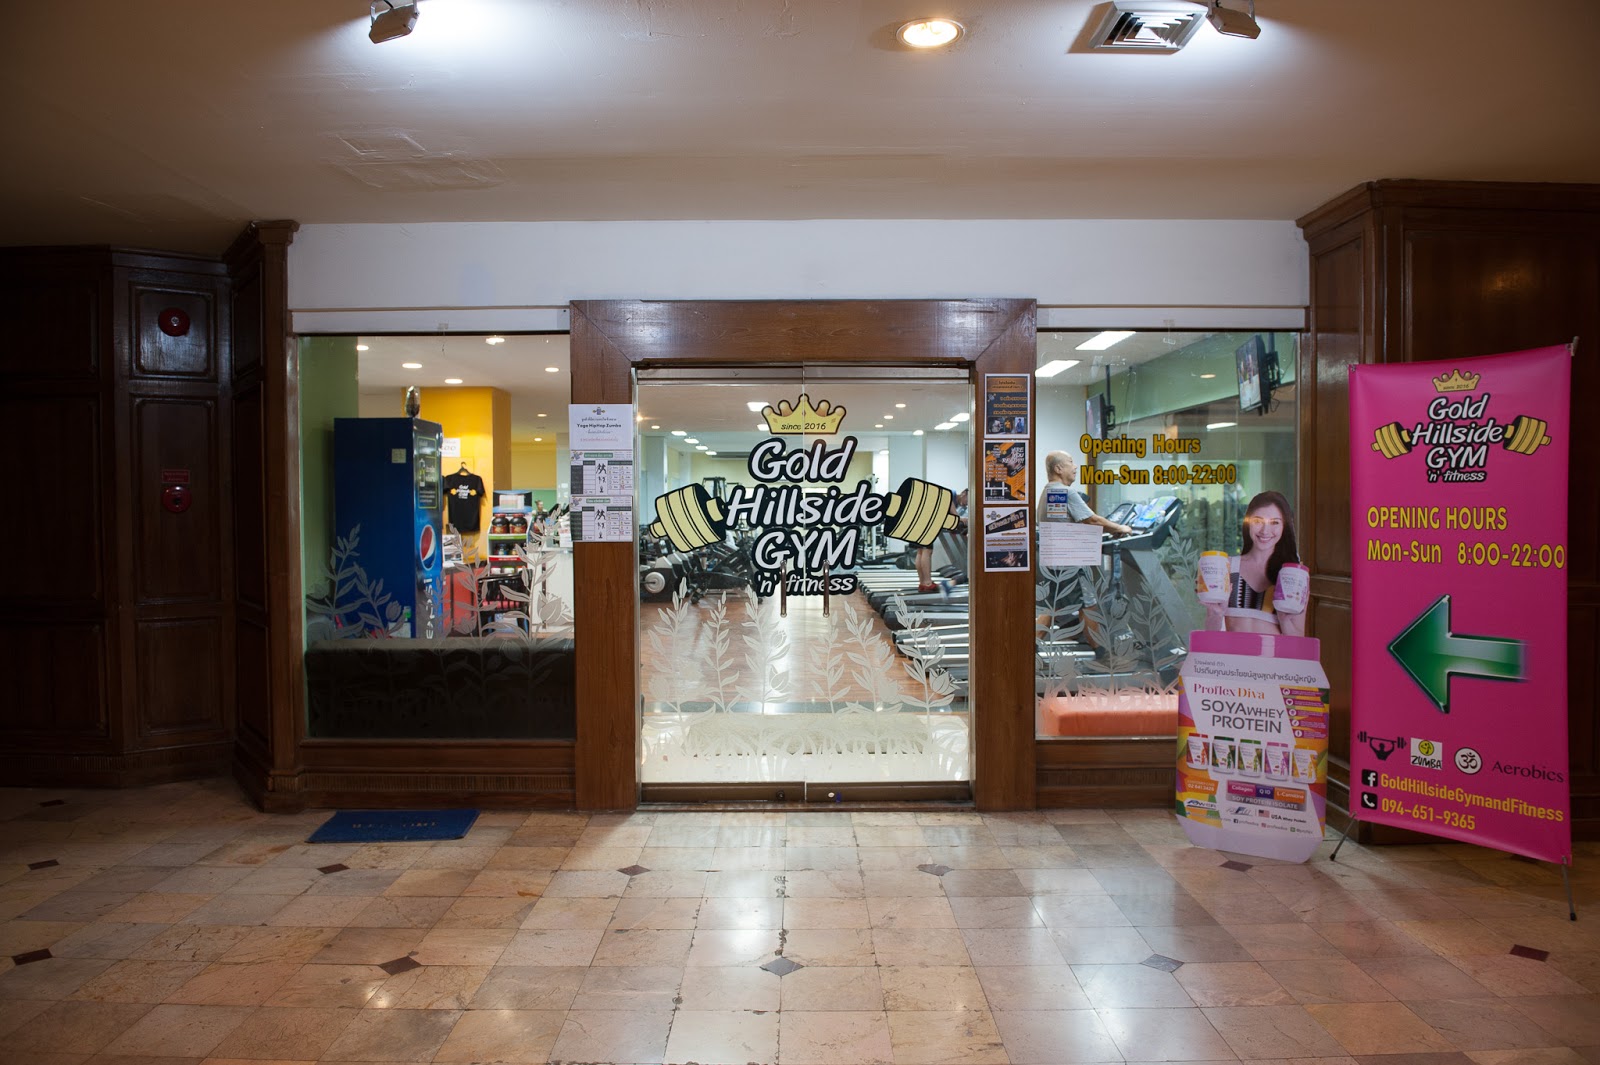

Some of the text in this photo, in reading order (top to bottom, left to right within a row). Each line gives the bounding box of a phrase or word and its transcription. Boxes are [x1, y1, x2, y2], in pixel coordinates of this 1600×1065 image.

[1428, 394, 1489, 420] Gold
[780, 422, 826, 431] since 2016
[1412, 420, 1503, 445] Hillside
[1080, 434, 1201, 458] Opening Hours
[1426, 445, 1488, 468] GYM
[749, 438, 856, 481] Gold
[1080, 464, 1236, 484] Mon-Sun 8:00-22:00
[1443, 470, 1486, 482] fitness
[725, 482, 885, 528] Hillside
[1368, 506, 1508, 530] OPENING HOURS
[754, 527, 858, 571] GYM
[1367, 540, 1565, 568] Mon-Sun 8:00-22:00
[786, 573, 854, 594] fitness
[1194, 683, 1265, 700] Proflex Diva
[1212, 714, 1282, 733] PROTEIN
[1412, 756, 1442, 768] ZUMBA
[1492, 762, 1564, 783] Aerobics
[1232, 785, 1253, 793] Collagen
[1381, 774, 1564, 822] GoldHillsideGymandFitness
[1246, 797, 1272, 805] PROTEIN
[1272, 800, 1298, 809] ISOLATE
[1382, 798, 1475, 830] 094-651-9365
